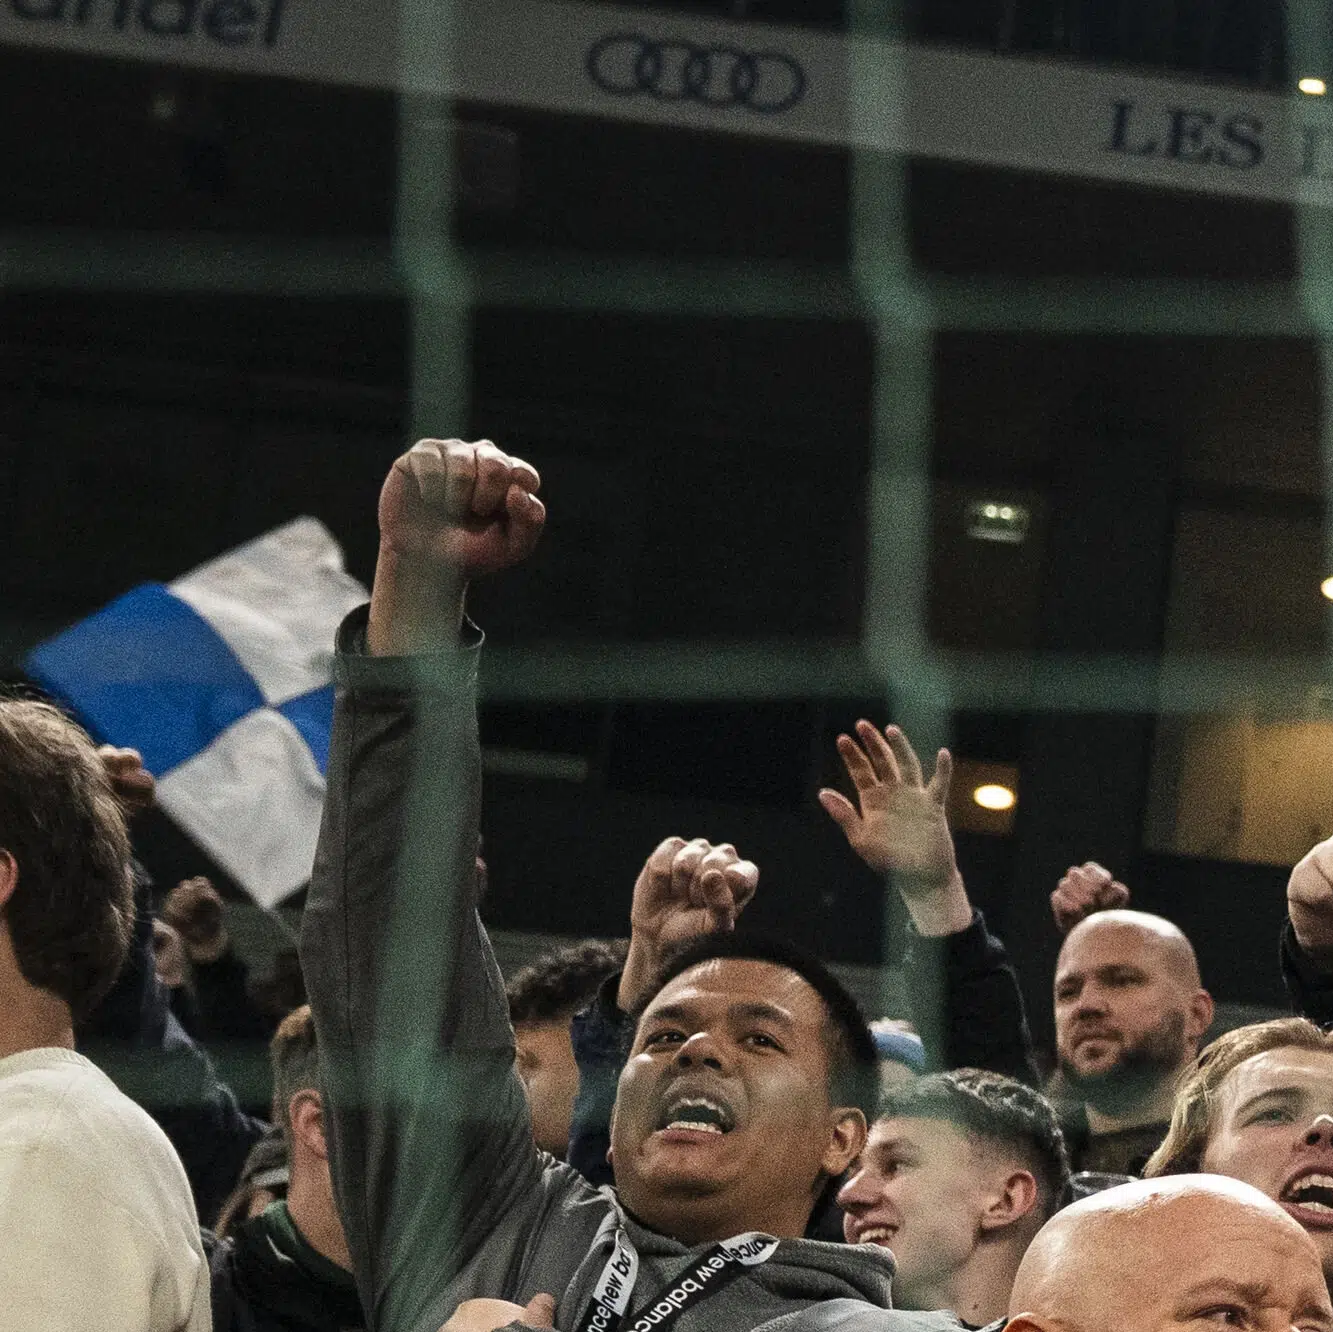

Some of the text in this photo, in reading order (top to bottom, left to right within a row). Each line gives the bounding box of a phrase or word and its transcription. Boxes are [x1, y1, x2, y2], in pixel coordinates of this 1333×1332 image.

[1102, 102, 1267, 169] LES
[695, 1251, 735, 1282] new
[601, 1272, 623, 1310] new
